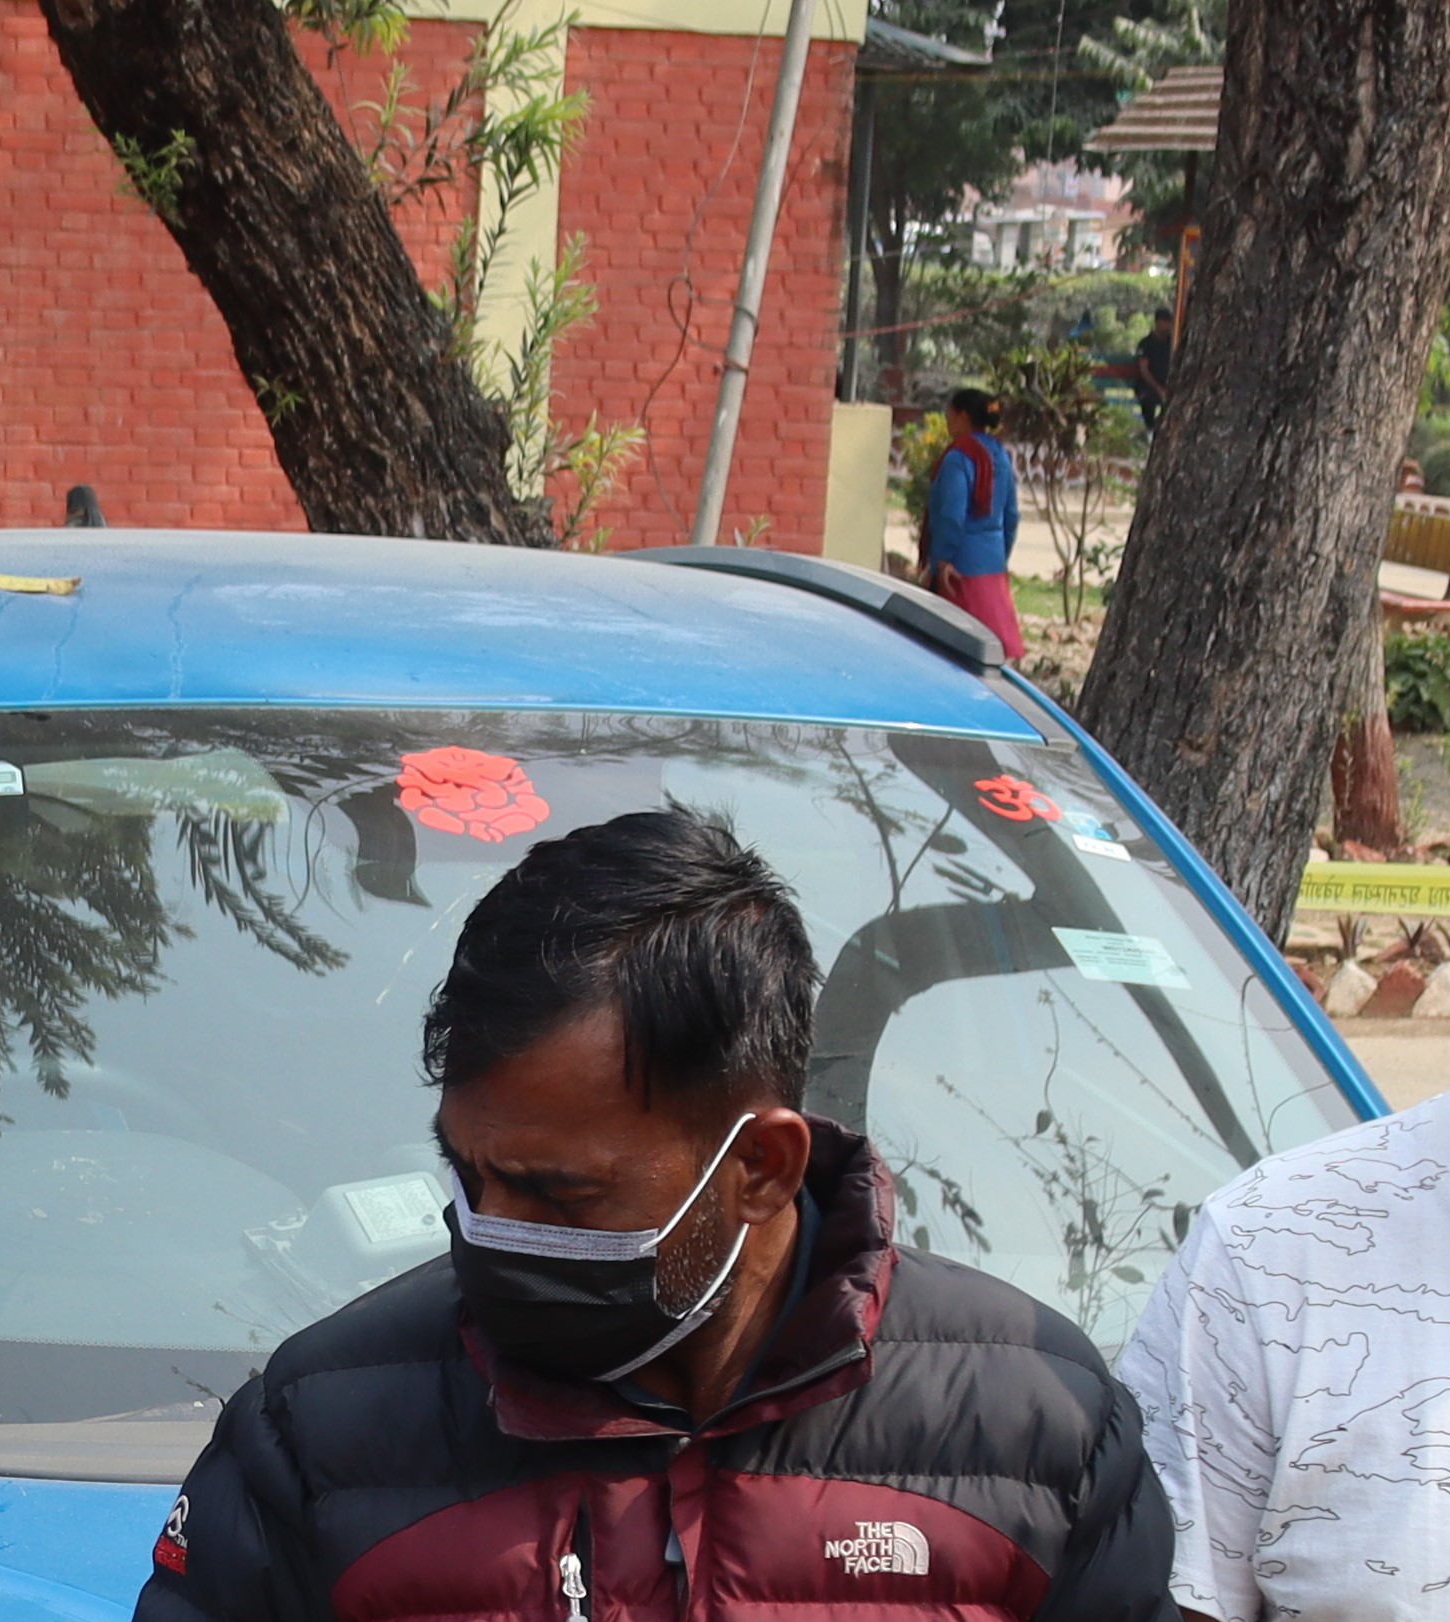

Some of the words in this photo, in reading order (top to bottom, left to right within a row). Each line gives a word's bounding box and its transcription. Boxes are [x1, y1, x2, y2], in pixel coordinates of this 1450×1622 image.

[854, 1521, 893, 1538] THE
[825, 1539, 893, 1559] NORTH
[844, 1556, 893, 1579] FACE
